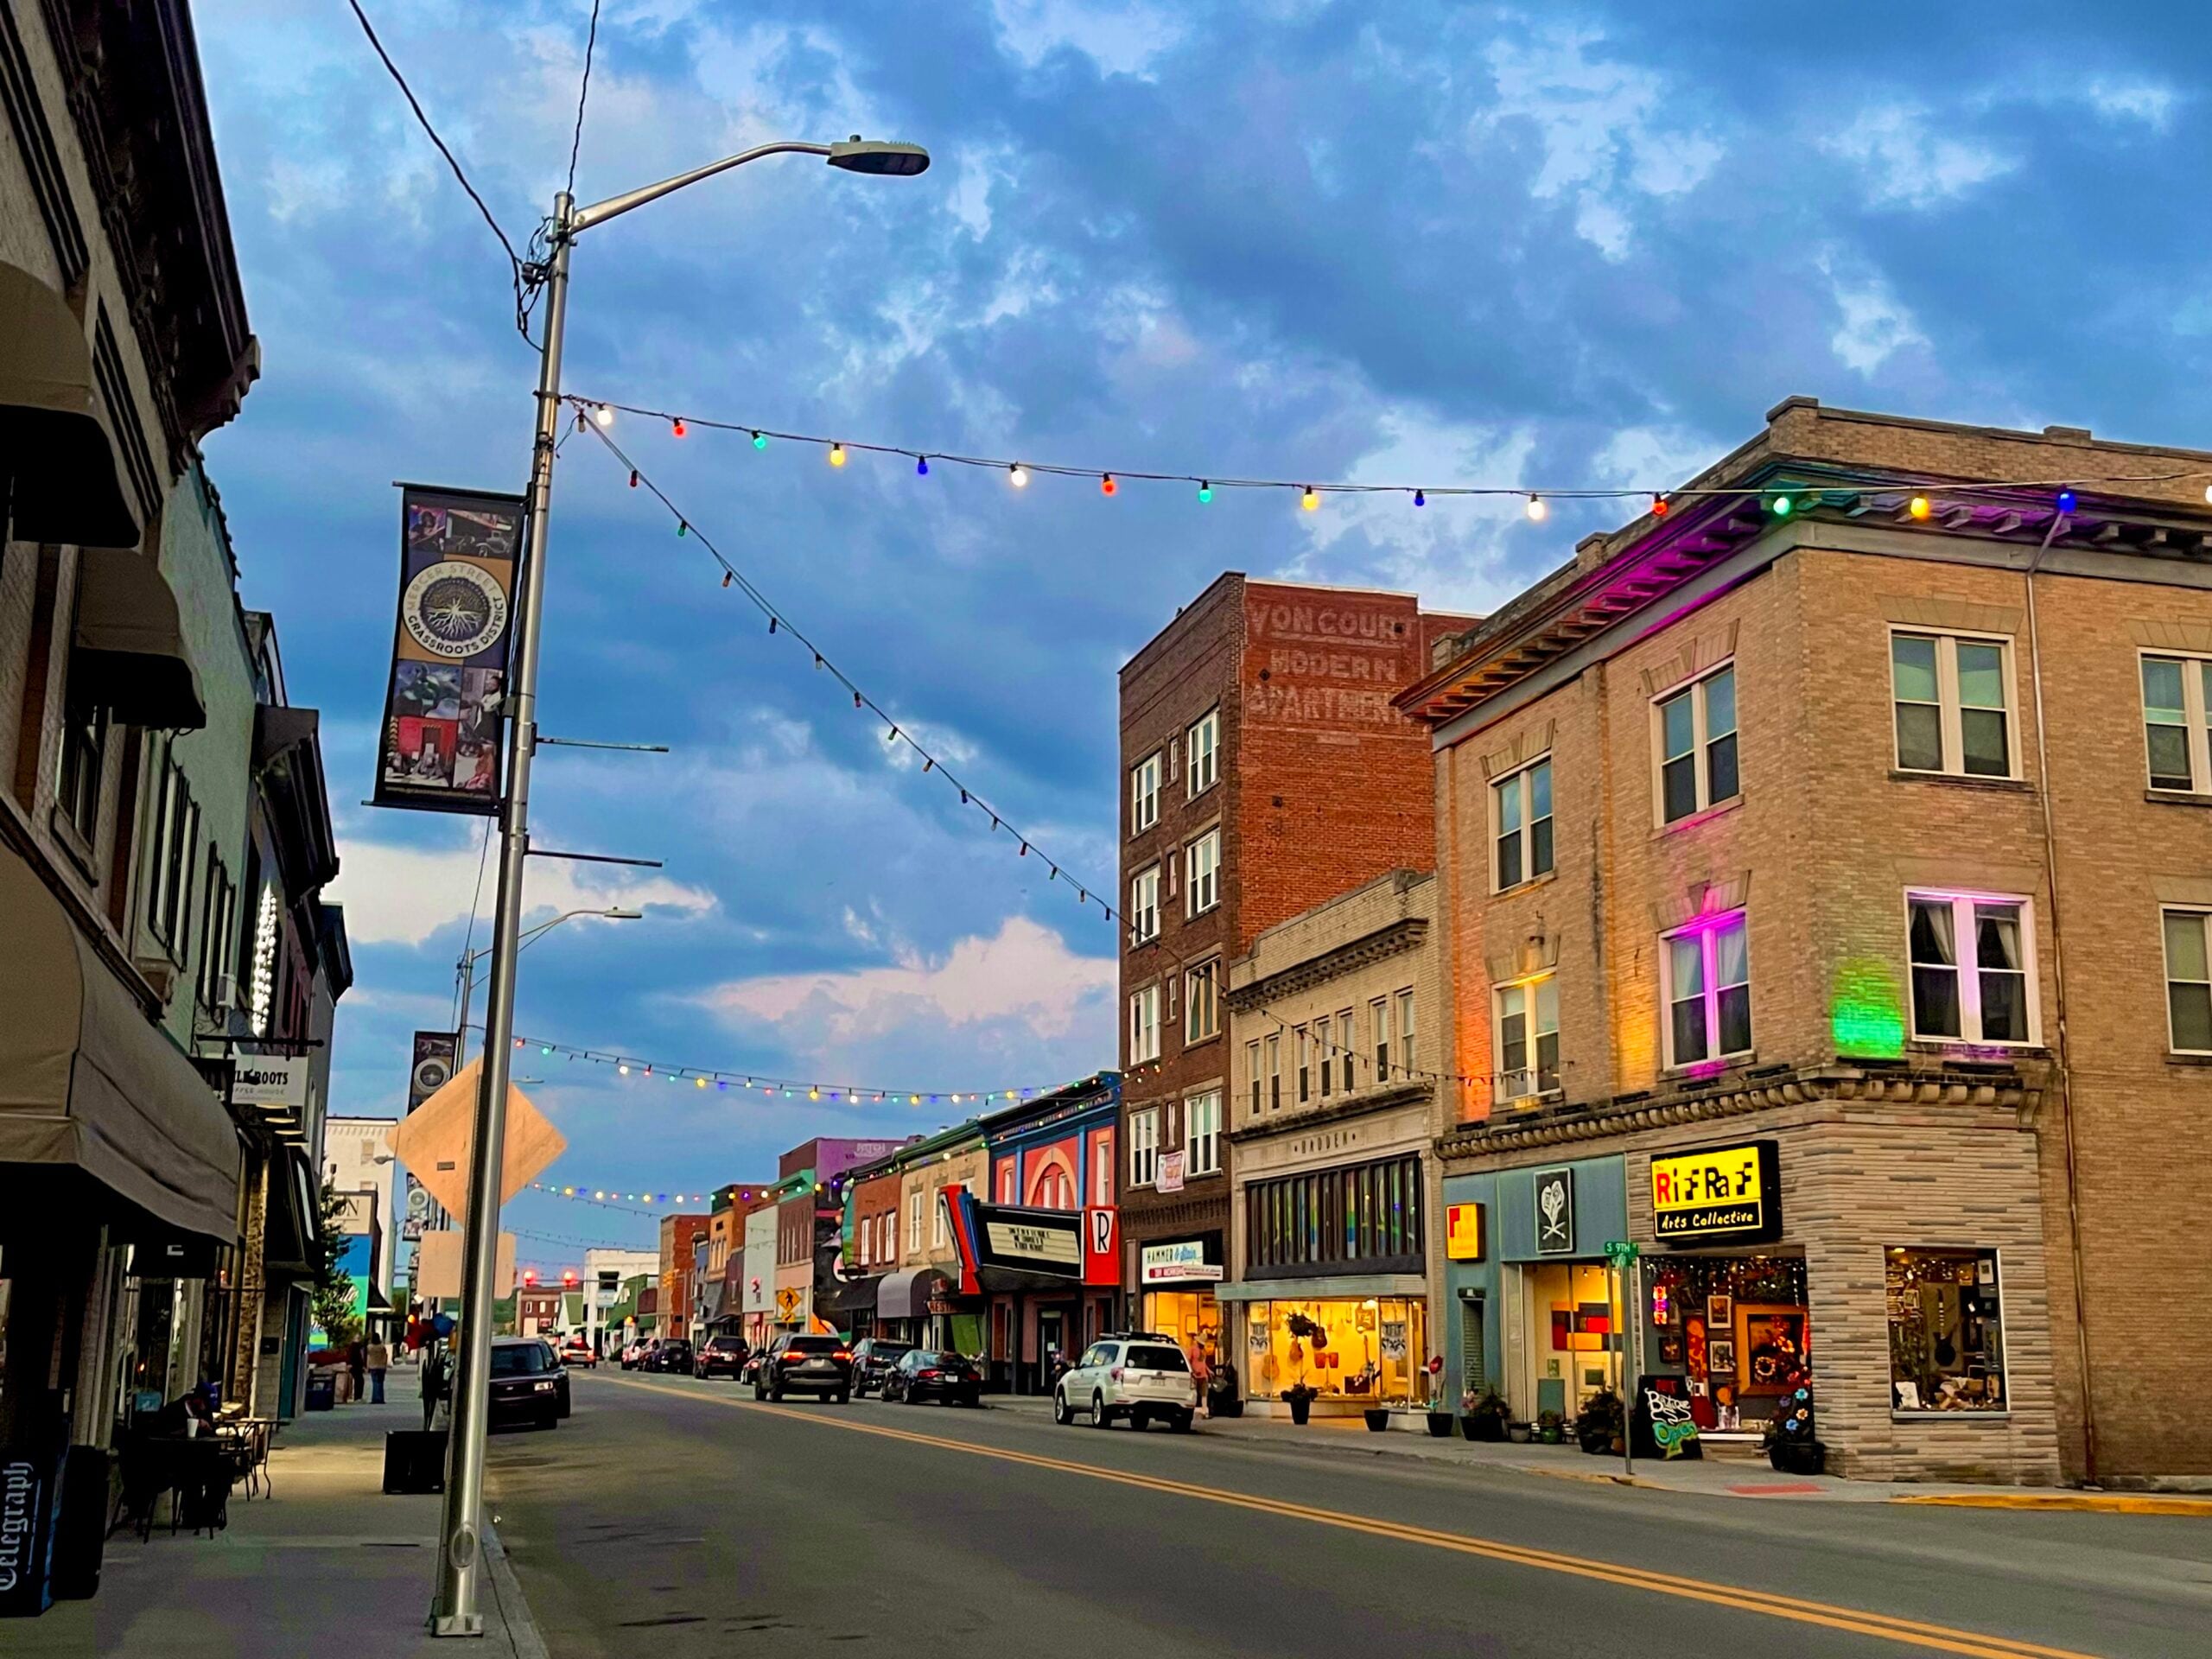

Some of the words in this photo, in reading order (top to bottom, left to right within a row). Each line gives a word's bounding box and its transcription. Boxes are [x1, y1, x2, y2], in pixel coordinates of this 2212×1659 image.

[407, 566, 444, 610] MERCER
[449, 563, 497, 594] STREET
[408, 614, 480, 654] GRASSROOTS
[480, 596, 505, 645] DISTRICT
[1270, 650, 1396, 682] MODERN
[1662, 1214, 1687, 1230] Arts
[1693, 1211, 1753, 1227] Collective
[1147, 1248, 1173, 1263] HAMMER
[1606, 1243, 1612, 1252] S
[1615, 1243, 1630, 1252] 9TH
